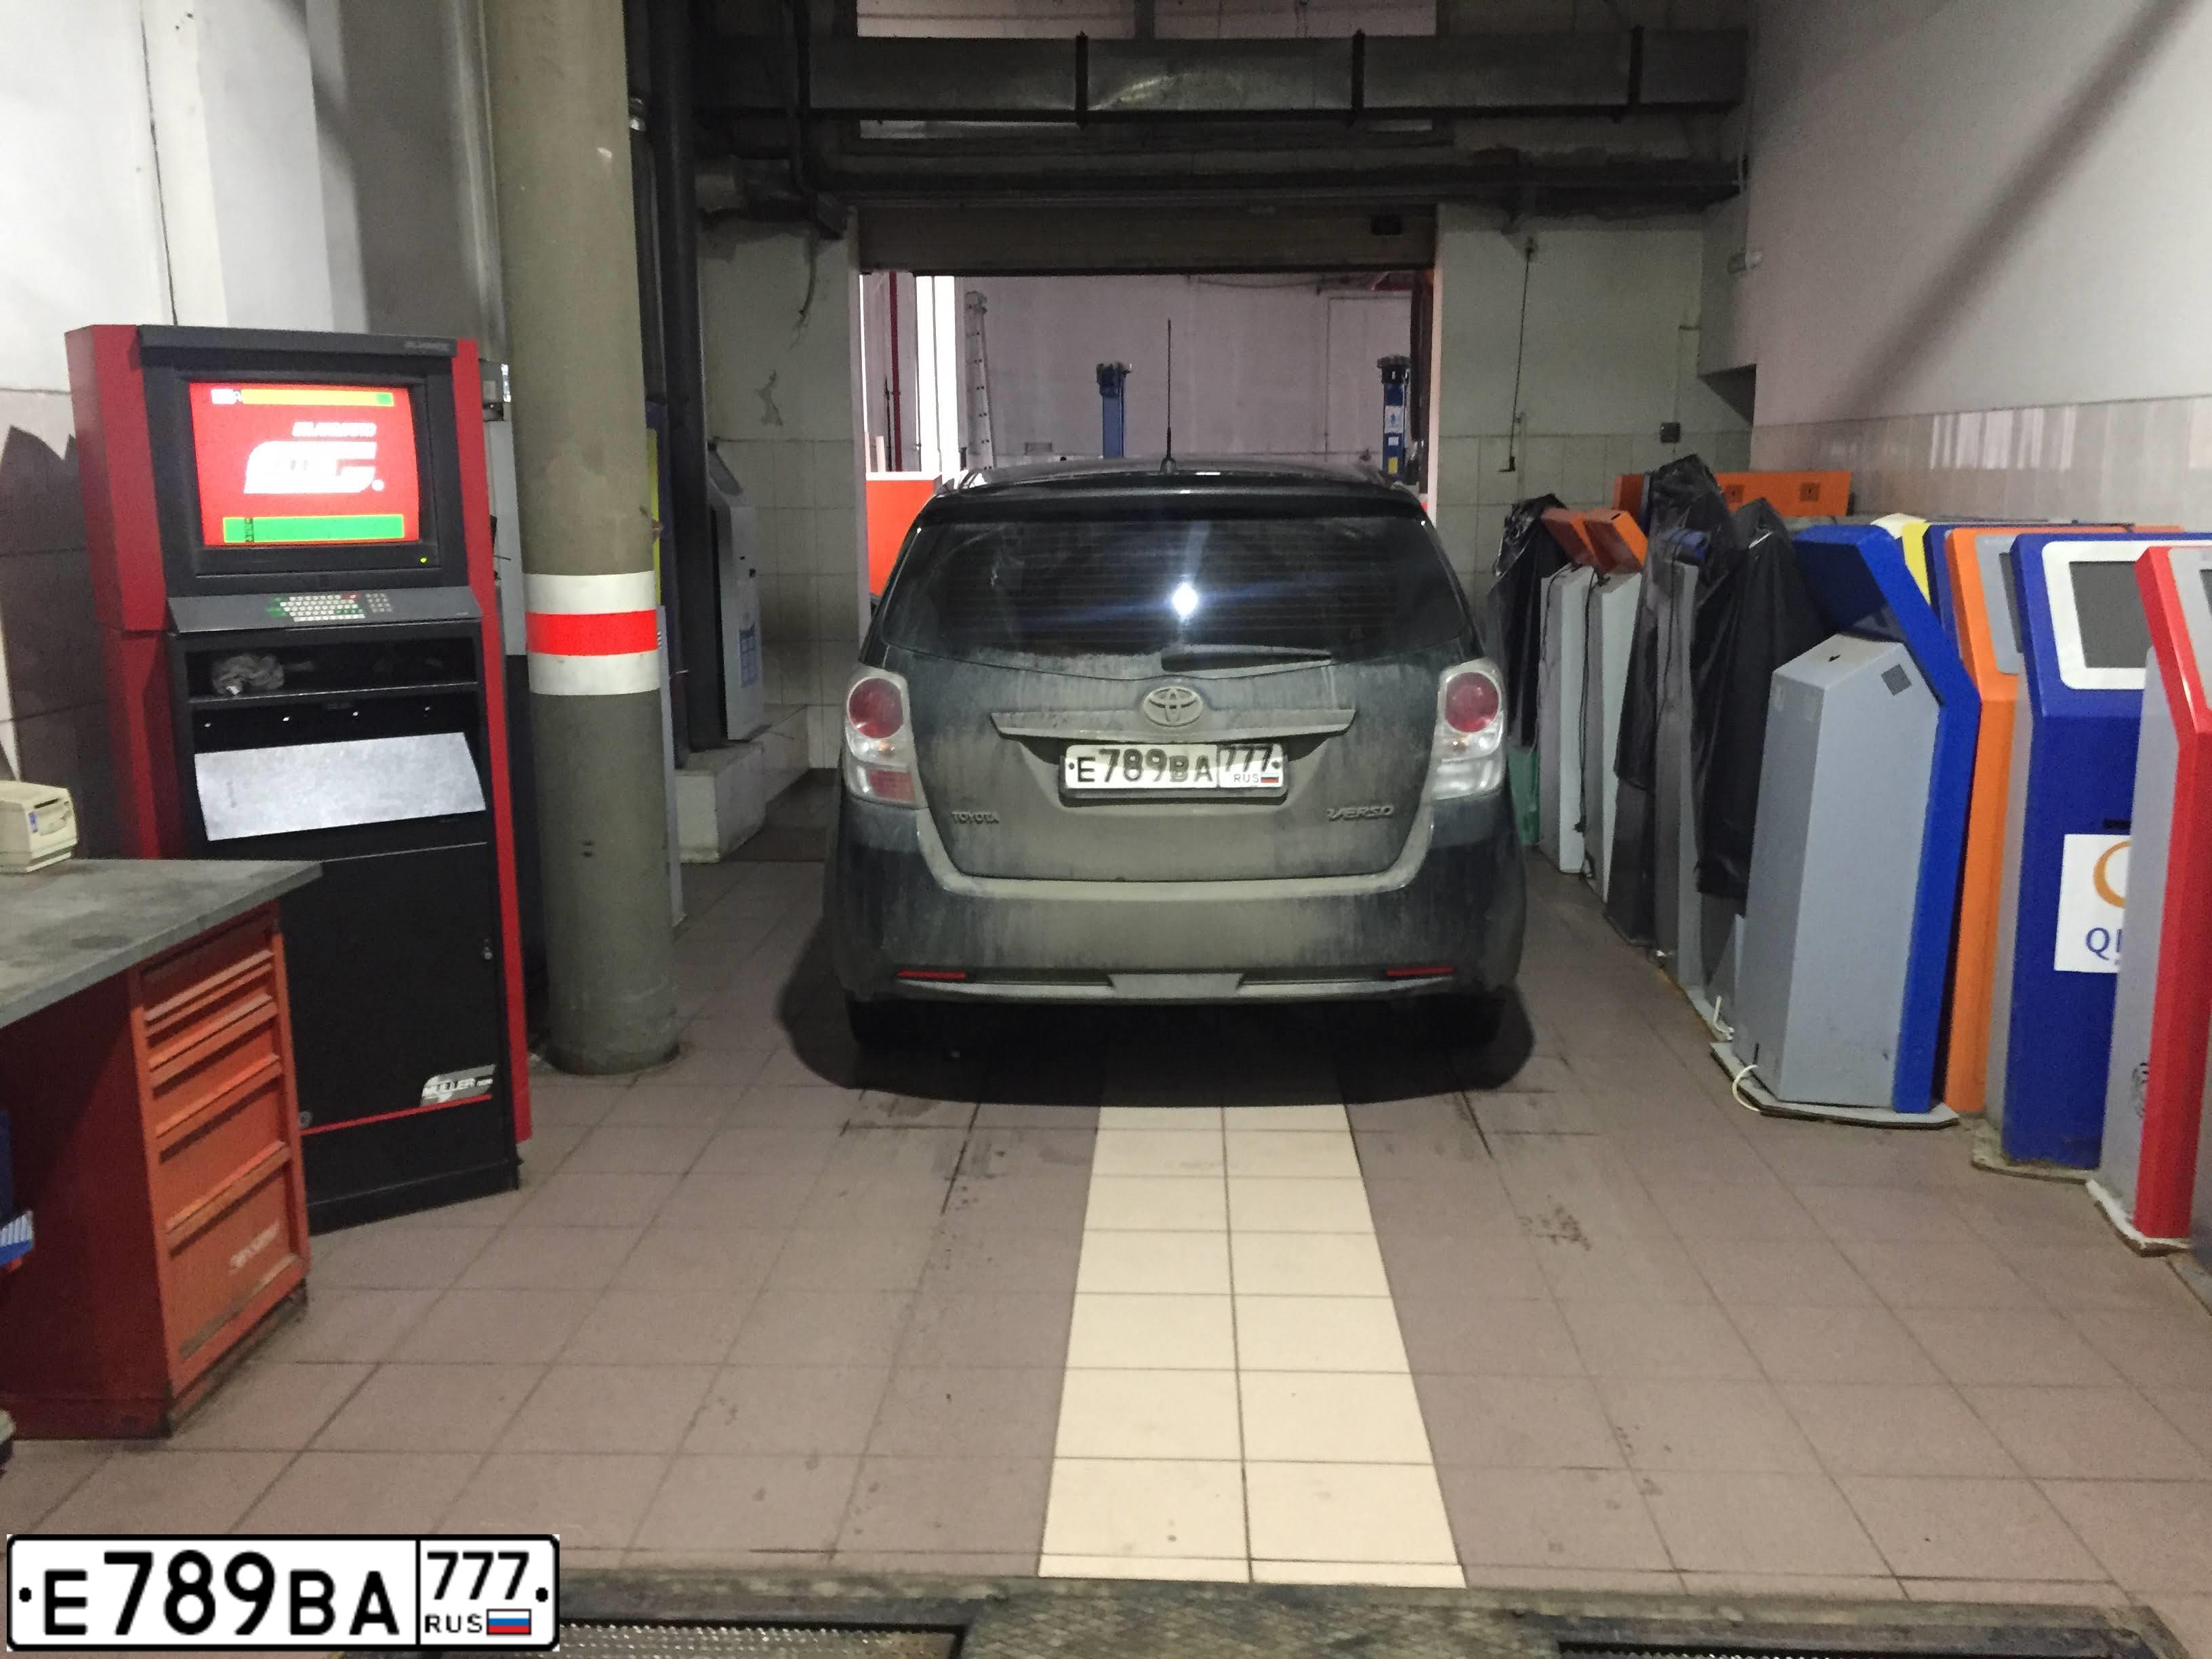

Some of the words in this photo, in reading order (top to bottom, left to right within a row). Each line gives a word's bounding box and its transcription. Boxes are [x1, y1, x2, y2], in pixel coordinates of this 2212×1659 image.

[1077, 748, 1214, 783] E789BA
[1219, 745, 1273, 773] 777
[1233, 773, 1259, 783] RUS
[950, 811, 1000, 825] TOYOTA
[1326, 805, 1394, 822] VERSO
